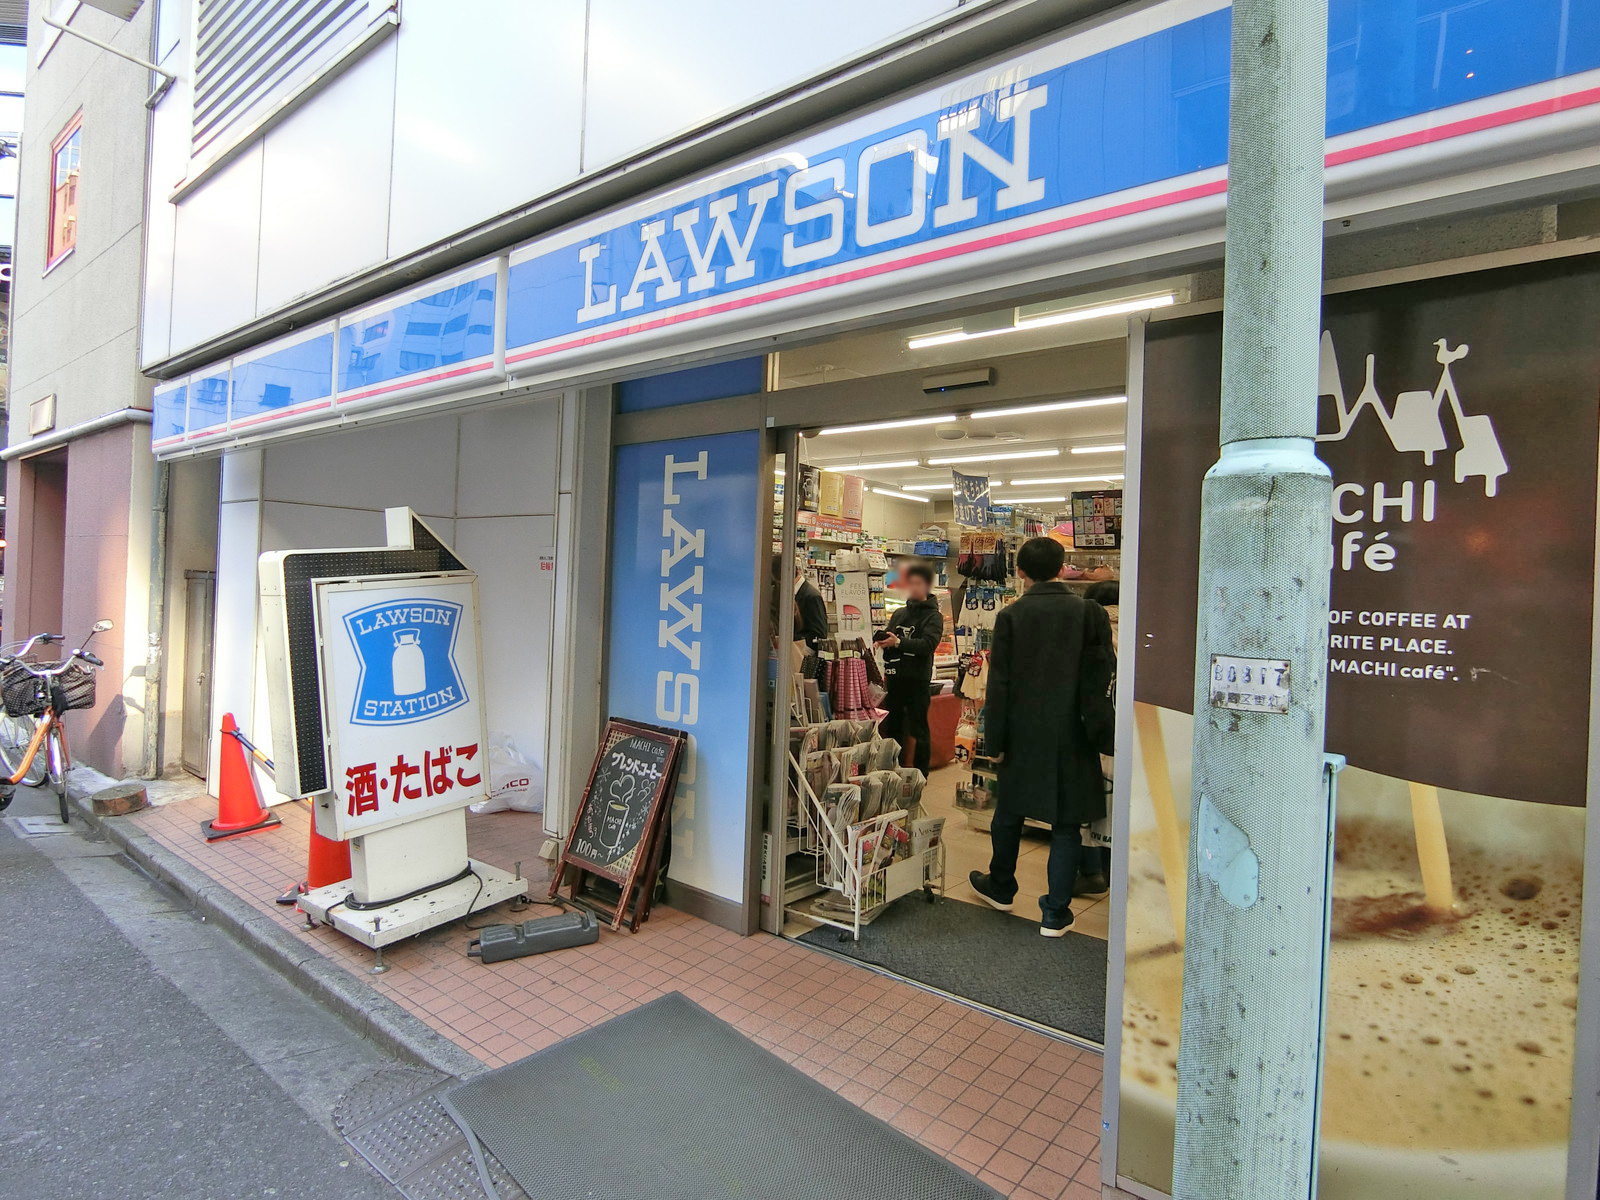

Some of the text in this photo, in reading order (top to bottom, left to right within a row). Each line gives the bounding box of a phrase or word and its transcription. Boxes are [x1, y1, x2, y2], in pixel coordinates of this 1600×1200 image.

[577, 84, 1048, 324] LAWSON
[1332, 480, 1435, 524] CHI
[1328, 531, 1397, 572] fé
[356, 608, 452, 635] LAWSON
[1329, 610, 1471, 630] OF COFFEE AT
[1329, 634, 1453, 656] RITE PLACE.
[1329, 658, 1397, 677] MACHI
[364, 686, 456, 717] STATION
[629, 739, 652, 752] MACHI
[345, 742, 482, 816] 酒・たばこ
[611, 752, 663, 780] ブレンドコーヒー
